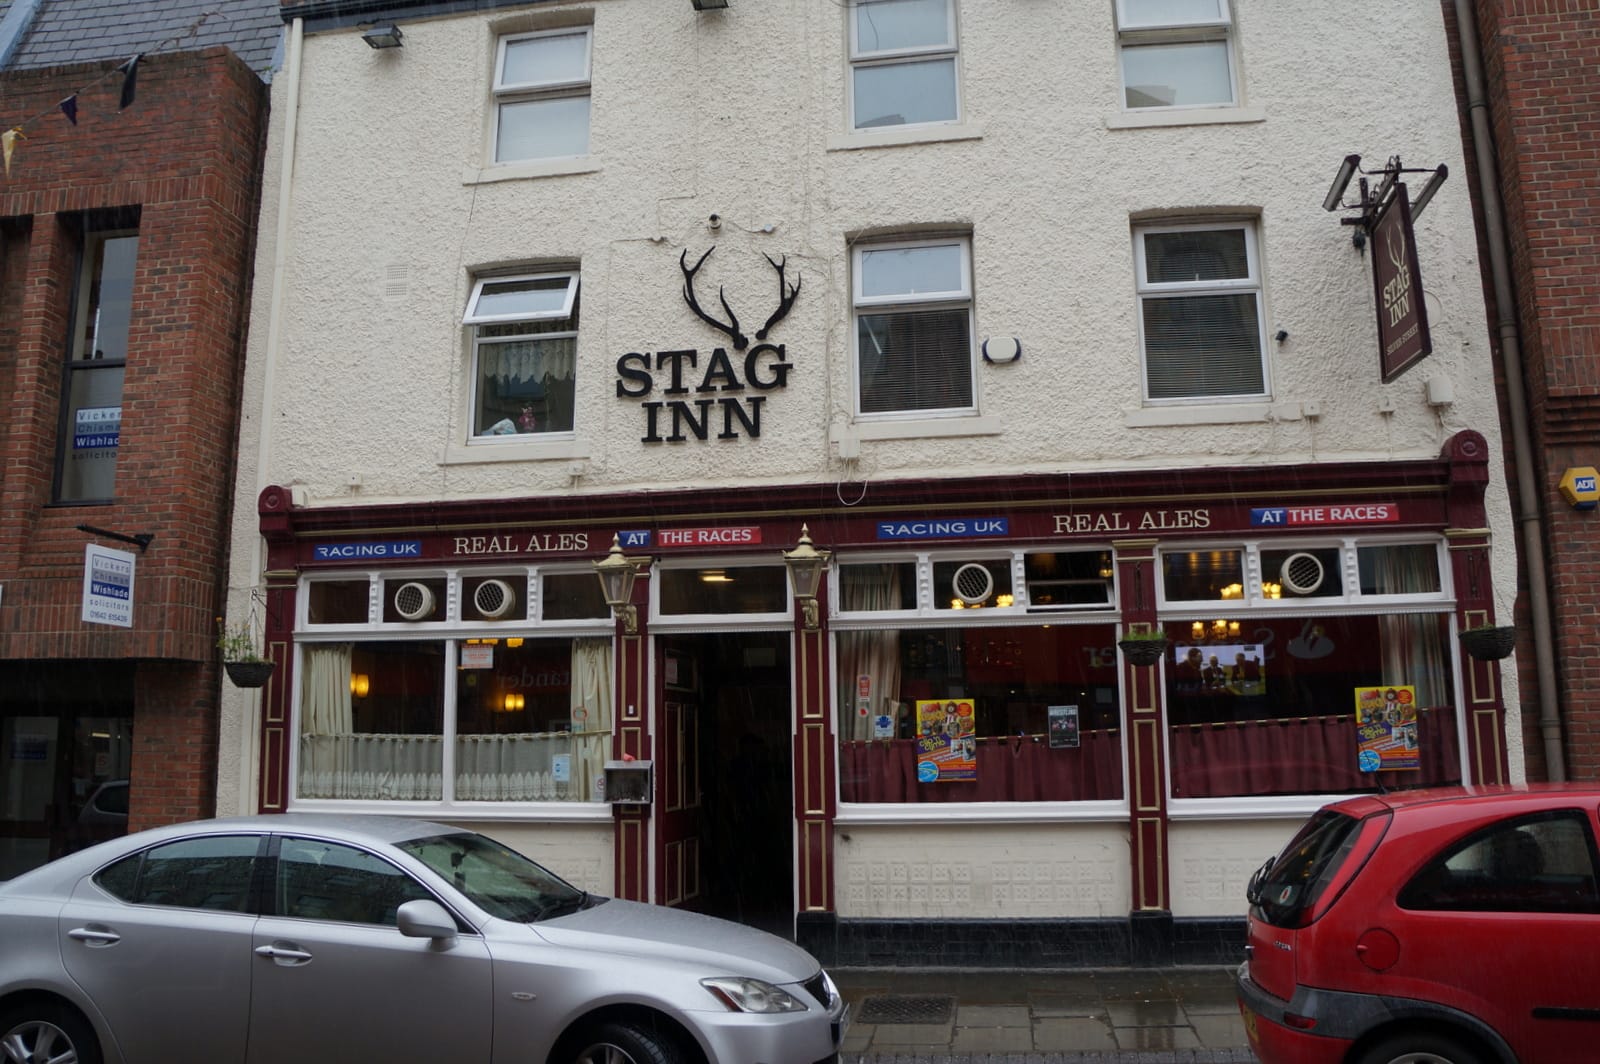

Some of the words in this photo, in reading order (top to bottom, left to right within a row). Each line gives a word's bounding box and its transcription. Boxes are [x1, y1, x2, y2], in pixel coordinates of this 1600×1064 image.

[1384, 264, 1410, 309] STAG
[1390, 291, 1409, 328] INN
[616, 344, 794, 397] STAG
[641, 396, 767, 443] INN
[1575, 480, 1595, 489] ADT
[1053, 512, 1130, 533] REAL
[1138, 509, 1211, 528] ALES
[1261, 510, 1284, 523] AT
[1288, 508, 1324, 522] THE
[1330, 506, 1389, 520] RACES
[881, 522, 967, 535] RACING
[974, 521, 1003, 532] UK
[453, 536, 519, 554] REAL
[525, 533, 589, 552] ALES
[626, 533, 648, 545] AT
[660, 531, 693, 544] THE
[698, 529, 752, 543] RACES
[317, 545, 387, 557] RACING
[393, 544, 417, 554] UK
[92, 583, 129, 598] Wishlade
[89, 599, 129, 611] solicitors
